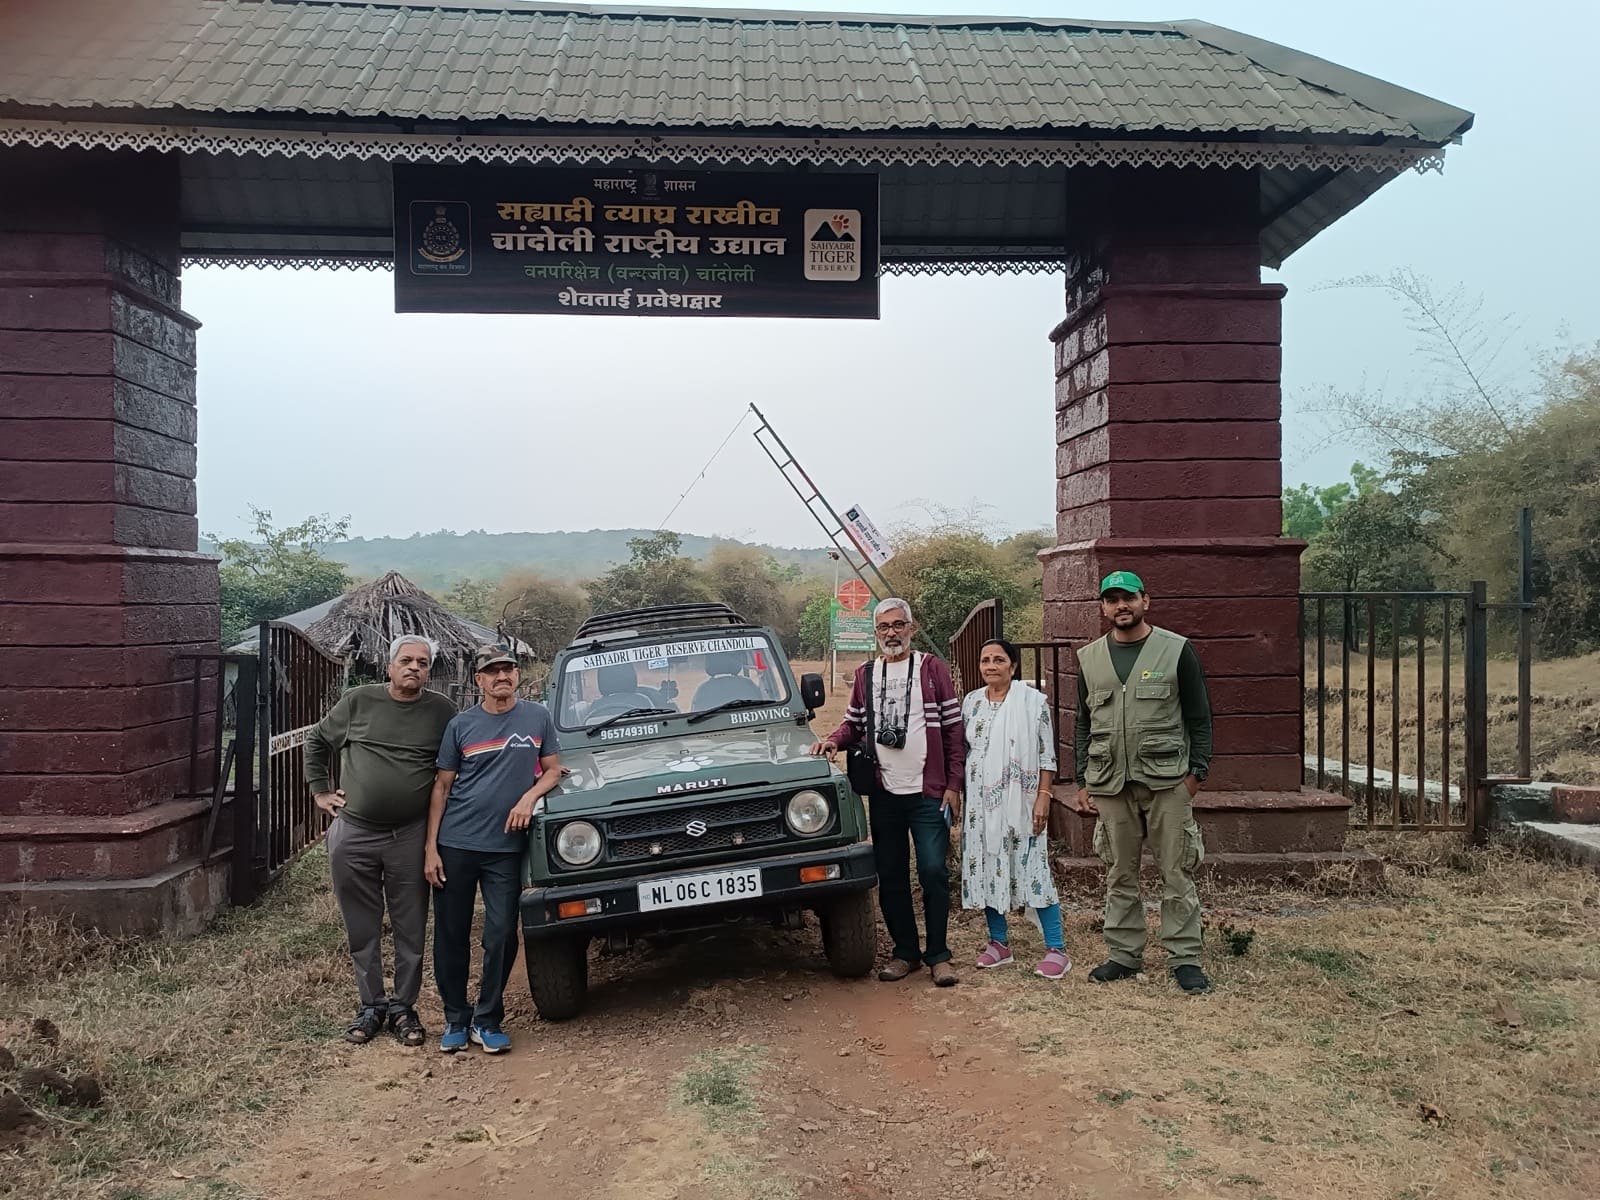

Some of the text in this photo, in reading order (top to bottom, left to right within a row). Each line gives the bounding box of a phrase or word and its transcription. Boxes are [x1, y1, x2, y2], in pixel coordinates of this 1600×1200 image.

[593, 178, 697, 194] महाराष्ट्र शासन
[496, 197, 781, 226] सह्याद्री व्याघ्र राखीव
[490, 225, 786, 258] चांदोली राष्ट्रीय उद्यान
[809, 250, 856, 263] TIGER
[524, 260, 601, 282] वनपरिक्षेत्र
[696, 262, 756, 283] चांदोली
[558, 286, 722, 310] शेवताई प्रवेशद्वार
[583, 637, 754, 669] SAHYADRI TIGER RESERVE CHANDOLI
[730, 707, 791, 724] BIRDWING
[600, 724, 659, 740] 9657493161
[656, 777, 728, 794] MARUTI
[652, 874, 757, 904] NL 06 C 1835
